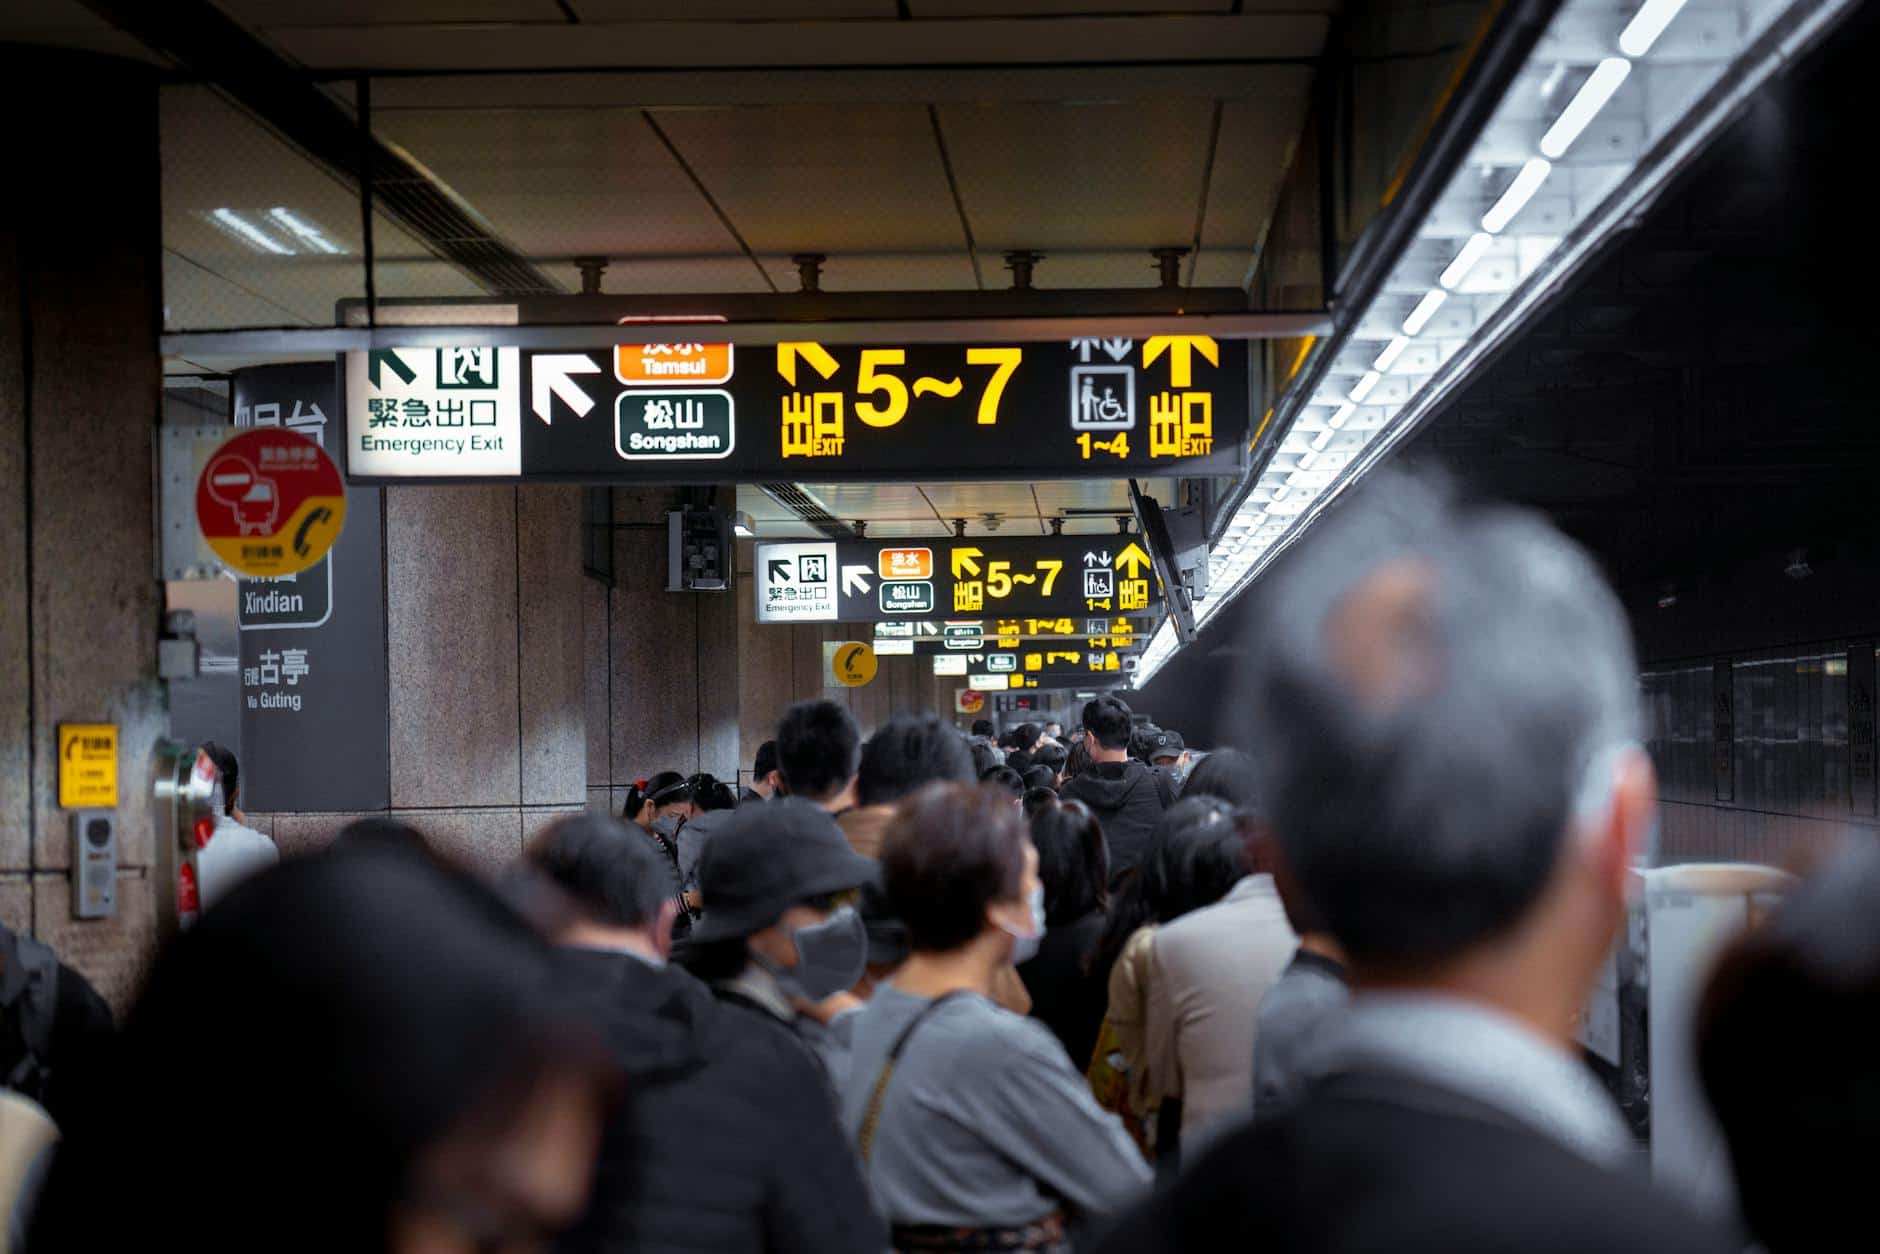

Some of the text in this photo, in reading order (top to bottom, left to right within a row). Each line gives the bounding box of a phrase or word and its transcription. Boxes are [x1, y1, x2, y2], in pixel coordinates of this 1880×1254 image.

[641, 358, 707, 375] Tamsui
[855, 347, 1023, 428] 5~7
[367, 398, 498, 429] 緊急出口
[643, 398, 705, 430] 松山
[781, 391, 845, 458] 出口
[1149, 391, 1213, 459] 出口
[360, 434, 504, 455] Emergency Exit
[629, 432, 721, 452] Songshan
[814, 438, 846, 456] EXIT
[1075, 431, 1131, 460] 1~4
[1182, 437, 1214, 456] EXIT
[985, 560, 1064, 599] 5~7
[244, 590, 304, 614] Xindian
[768, 586, 828, 602] 緊急出口
[892, 585, 921, 600] 松山
[953, 580, 984, 613] 出口
[1118, 579, 1149, 611] 出口
[766, 602, 831, 613] Emergency Exit
[886, 600, 928, 611] Songshan
[1085, 598, 1112, 612] 1~4
[259, 690, 302, 712] Guting
